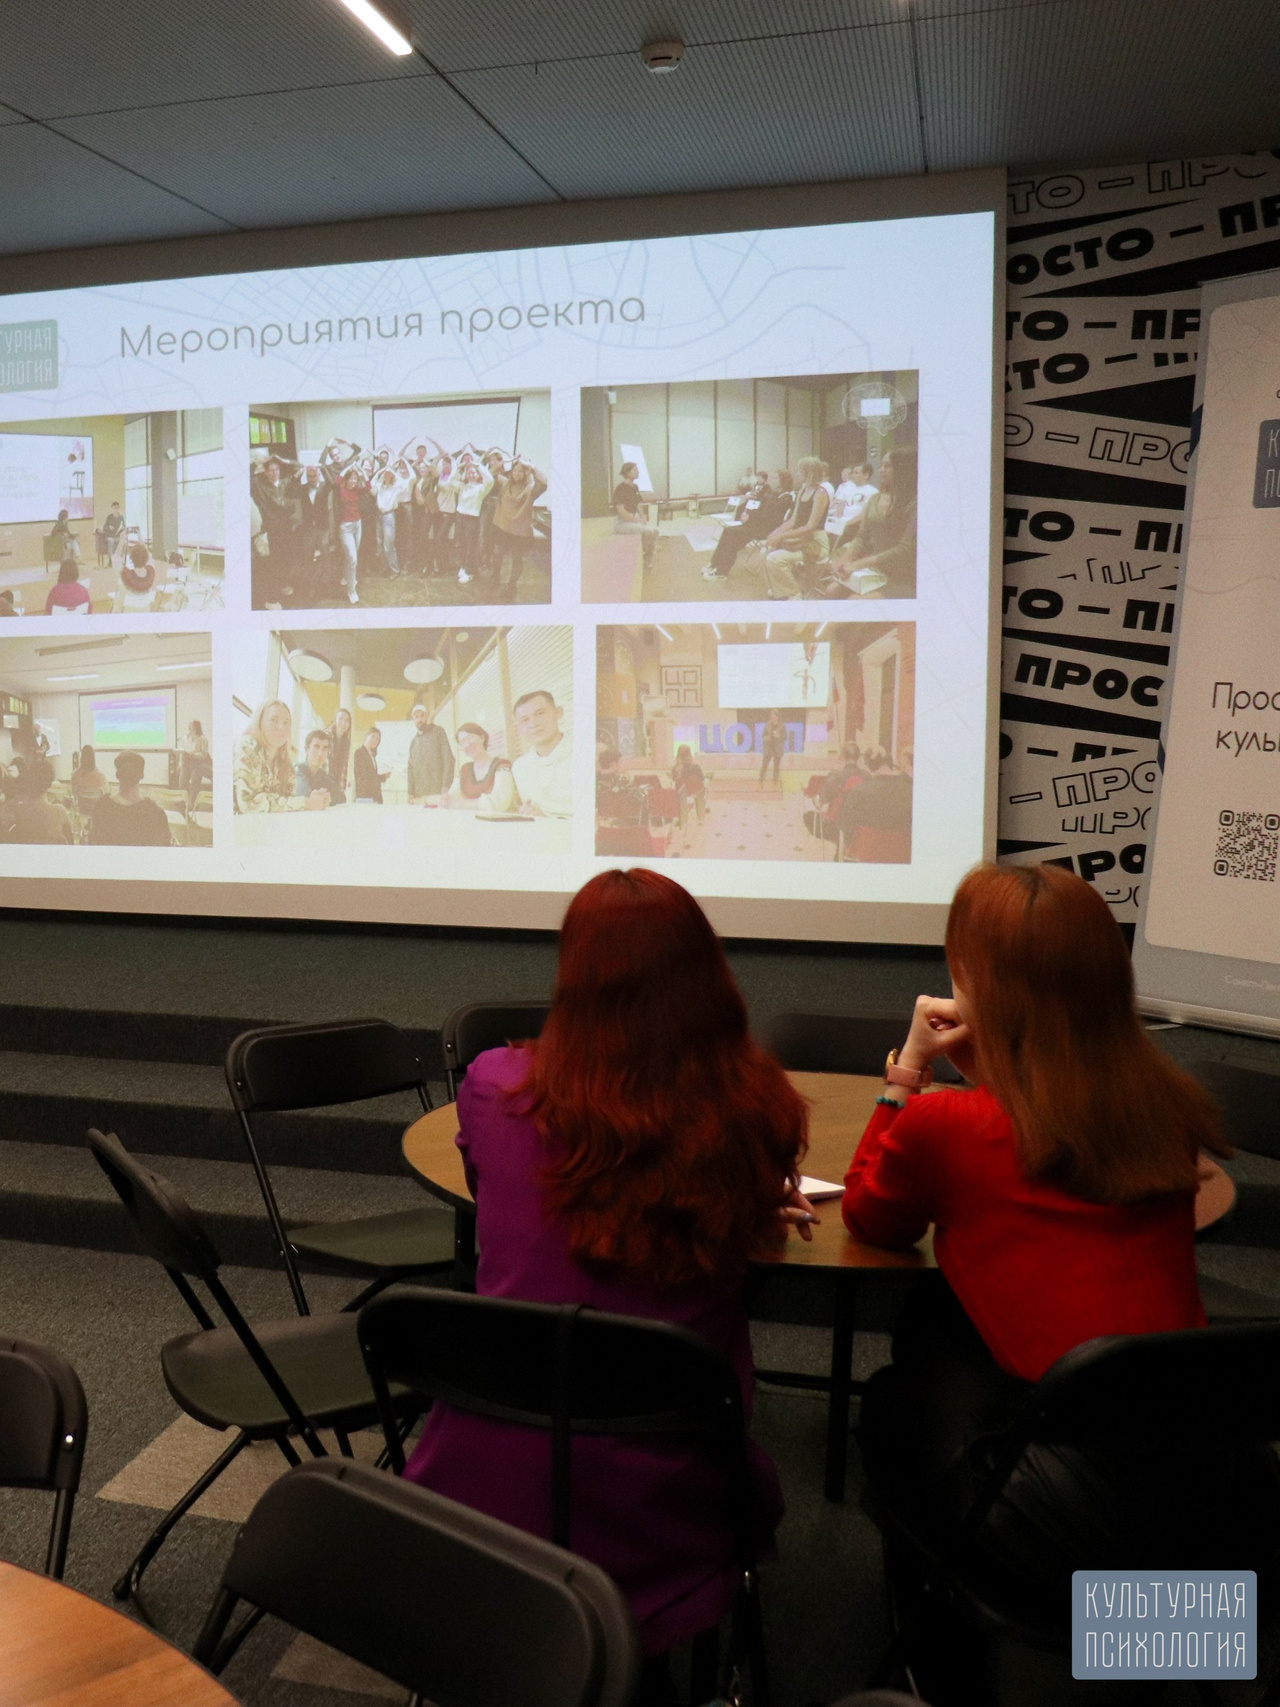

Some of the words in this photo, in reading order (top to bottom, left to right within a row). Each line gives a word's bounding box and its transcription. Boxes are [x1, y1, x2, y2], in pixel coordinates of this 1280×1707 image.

[119, 312, 423, 362] Мероприятия
[440, 297, 646, 343] проекта
[1004, 352, 1089, 393] ТО
[1014, 652, 1165, 708] ПРОС
[1215, 729, 1280, 759] куль
